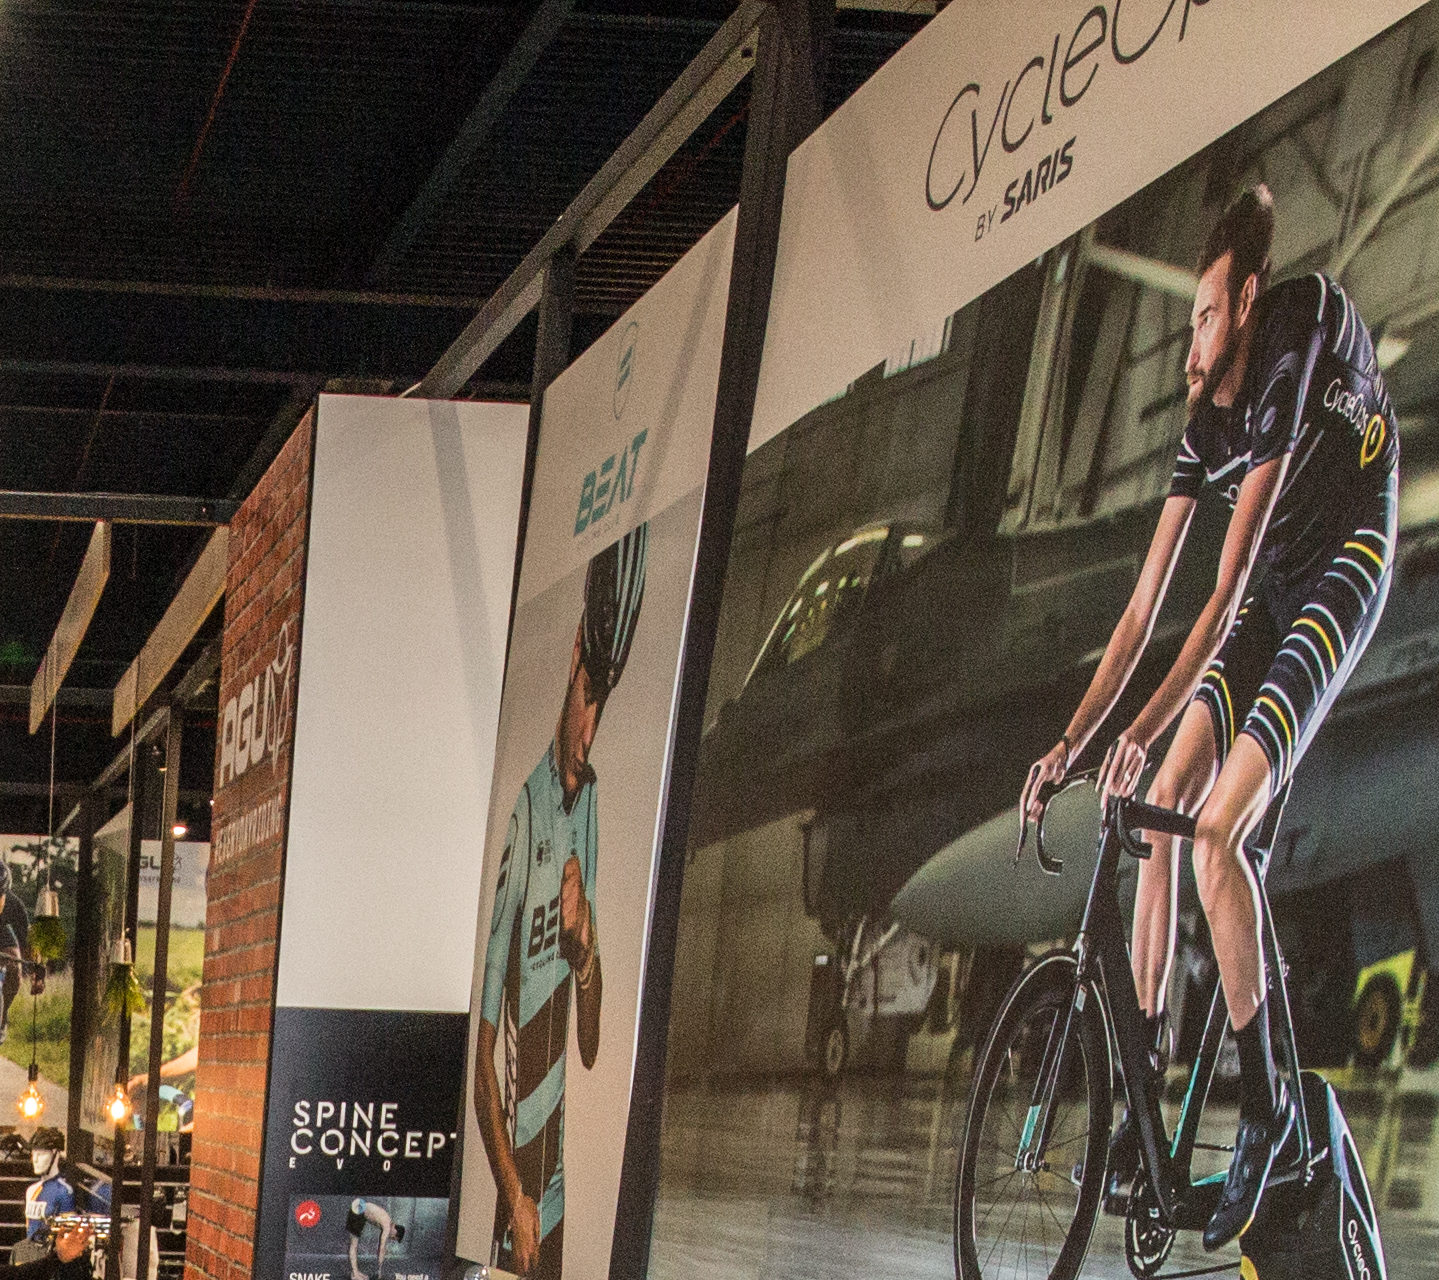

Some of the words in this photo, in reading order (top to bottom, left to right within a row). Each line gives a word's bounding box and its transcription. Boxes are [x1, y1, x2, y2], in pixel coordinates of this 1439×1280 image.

[975, 204, 997, 242] BY
[1000, 136, 1077, 224] SARIS
[573, 428, 648, 537] BEAT
[220, 667, 272, 789] AGU
[527, 895, 561, 959] BE
[293, 1100, 399, 1130] SPINE
